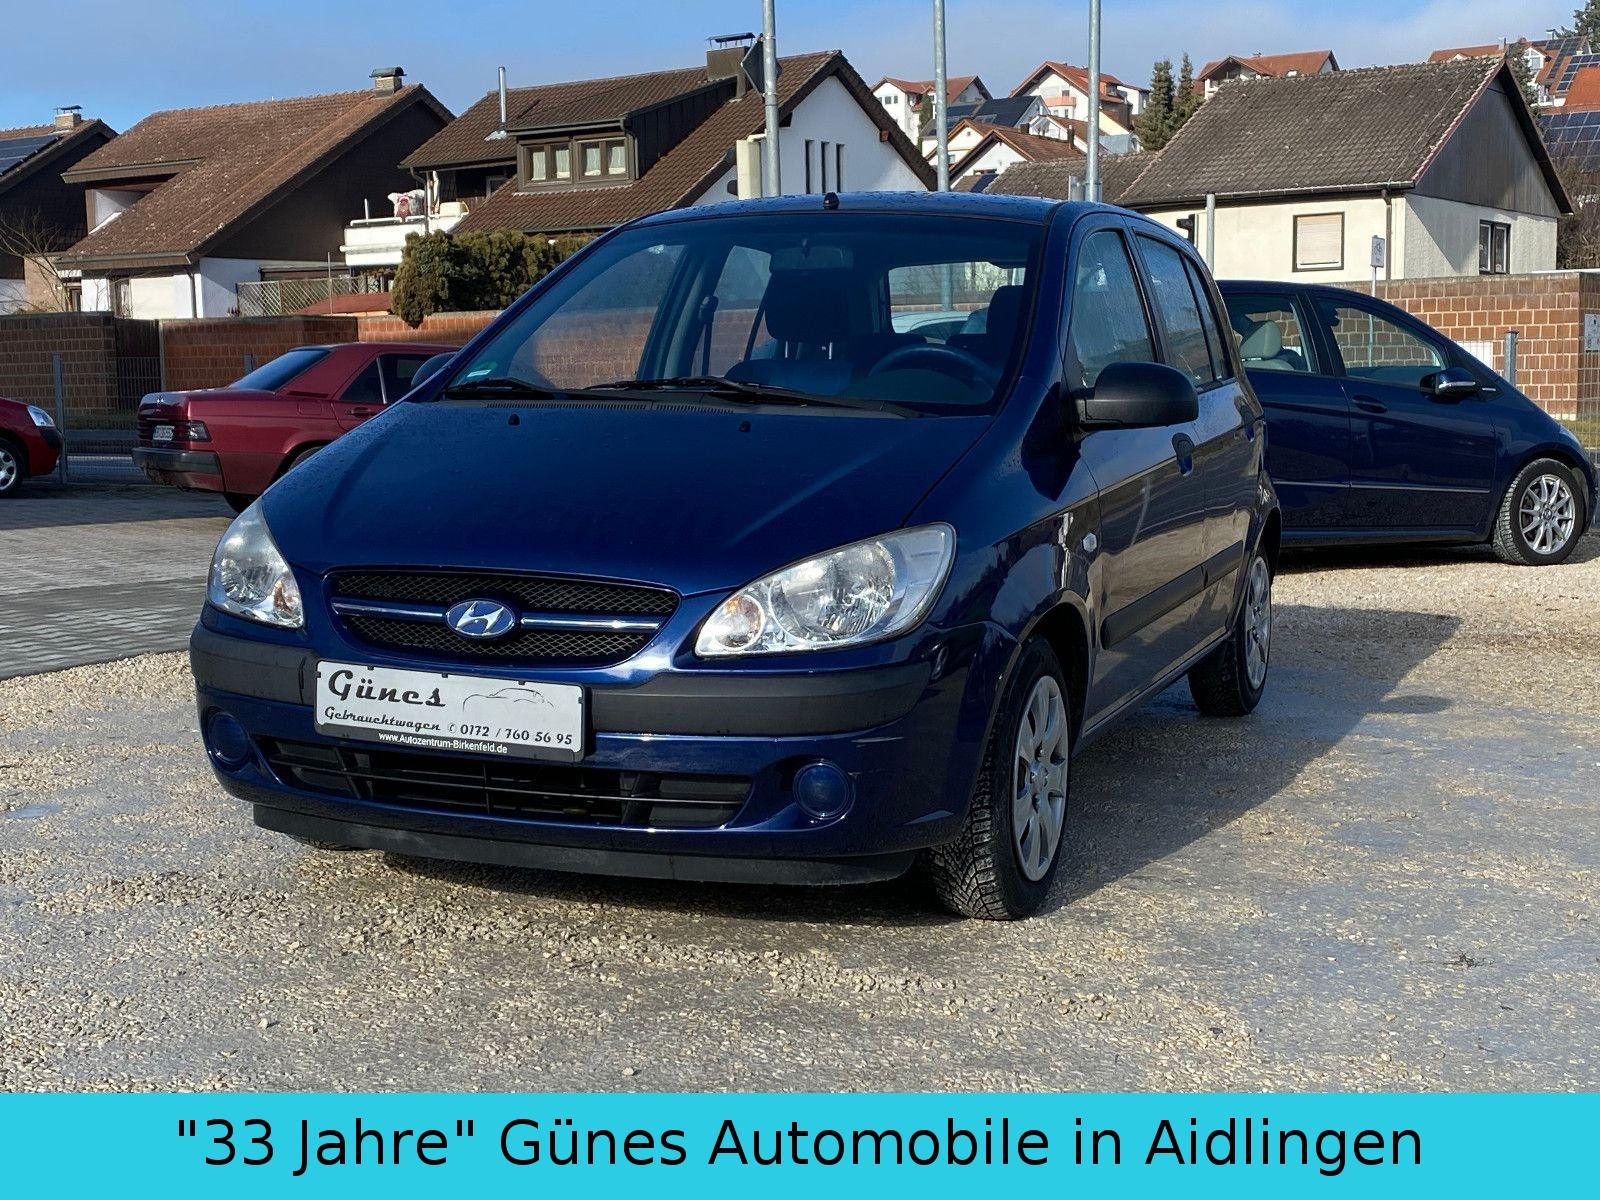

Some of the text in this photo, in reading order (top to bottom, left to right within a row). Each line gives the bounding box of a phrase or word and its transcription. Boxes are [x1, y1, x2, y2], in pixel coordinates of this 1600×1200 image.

[328, 669, 446, 707] Günes
[324, 706, 441, 732] Gebrauchtwagen
[460, 724, 490, 737] 0172
[505, 728, 530, 741] 760
[535, 731, 552, 743] 56
[556, 733, 573, 745] 95
[378, 732, 508, 753] www.Autozentrum-Birkenfeld.de
